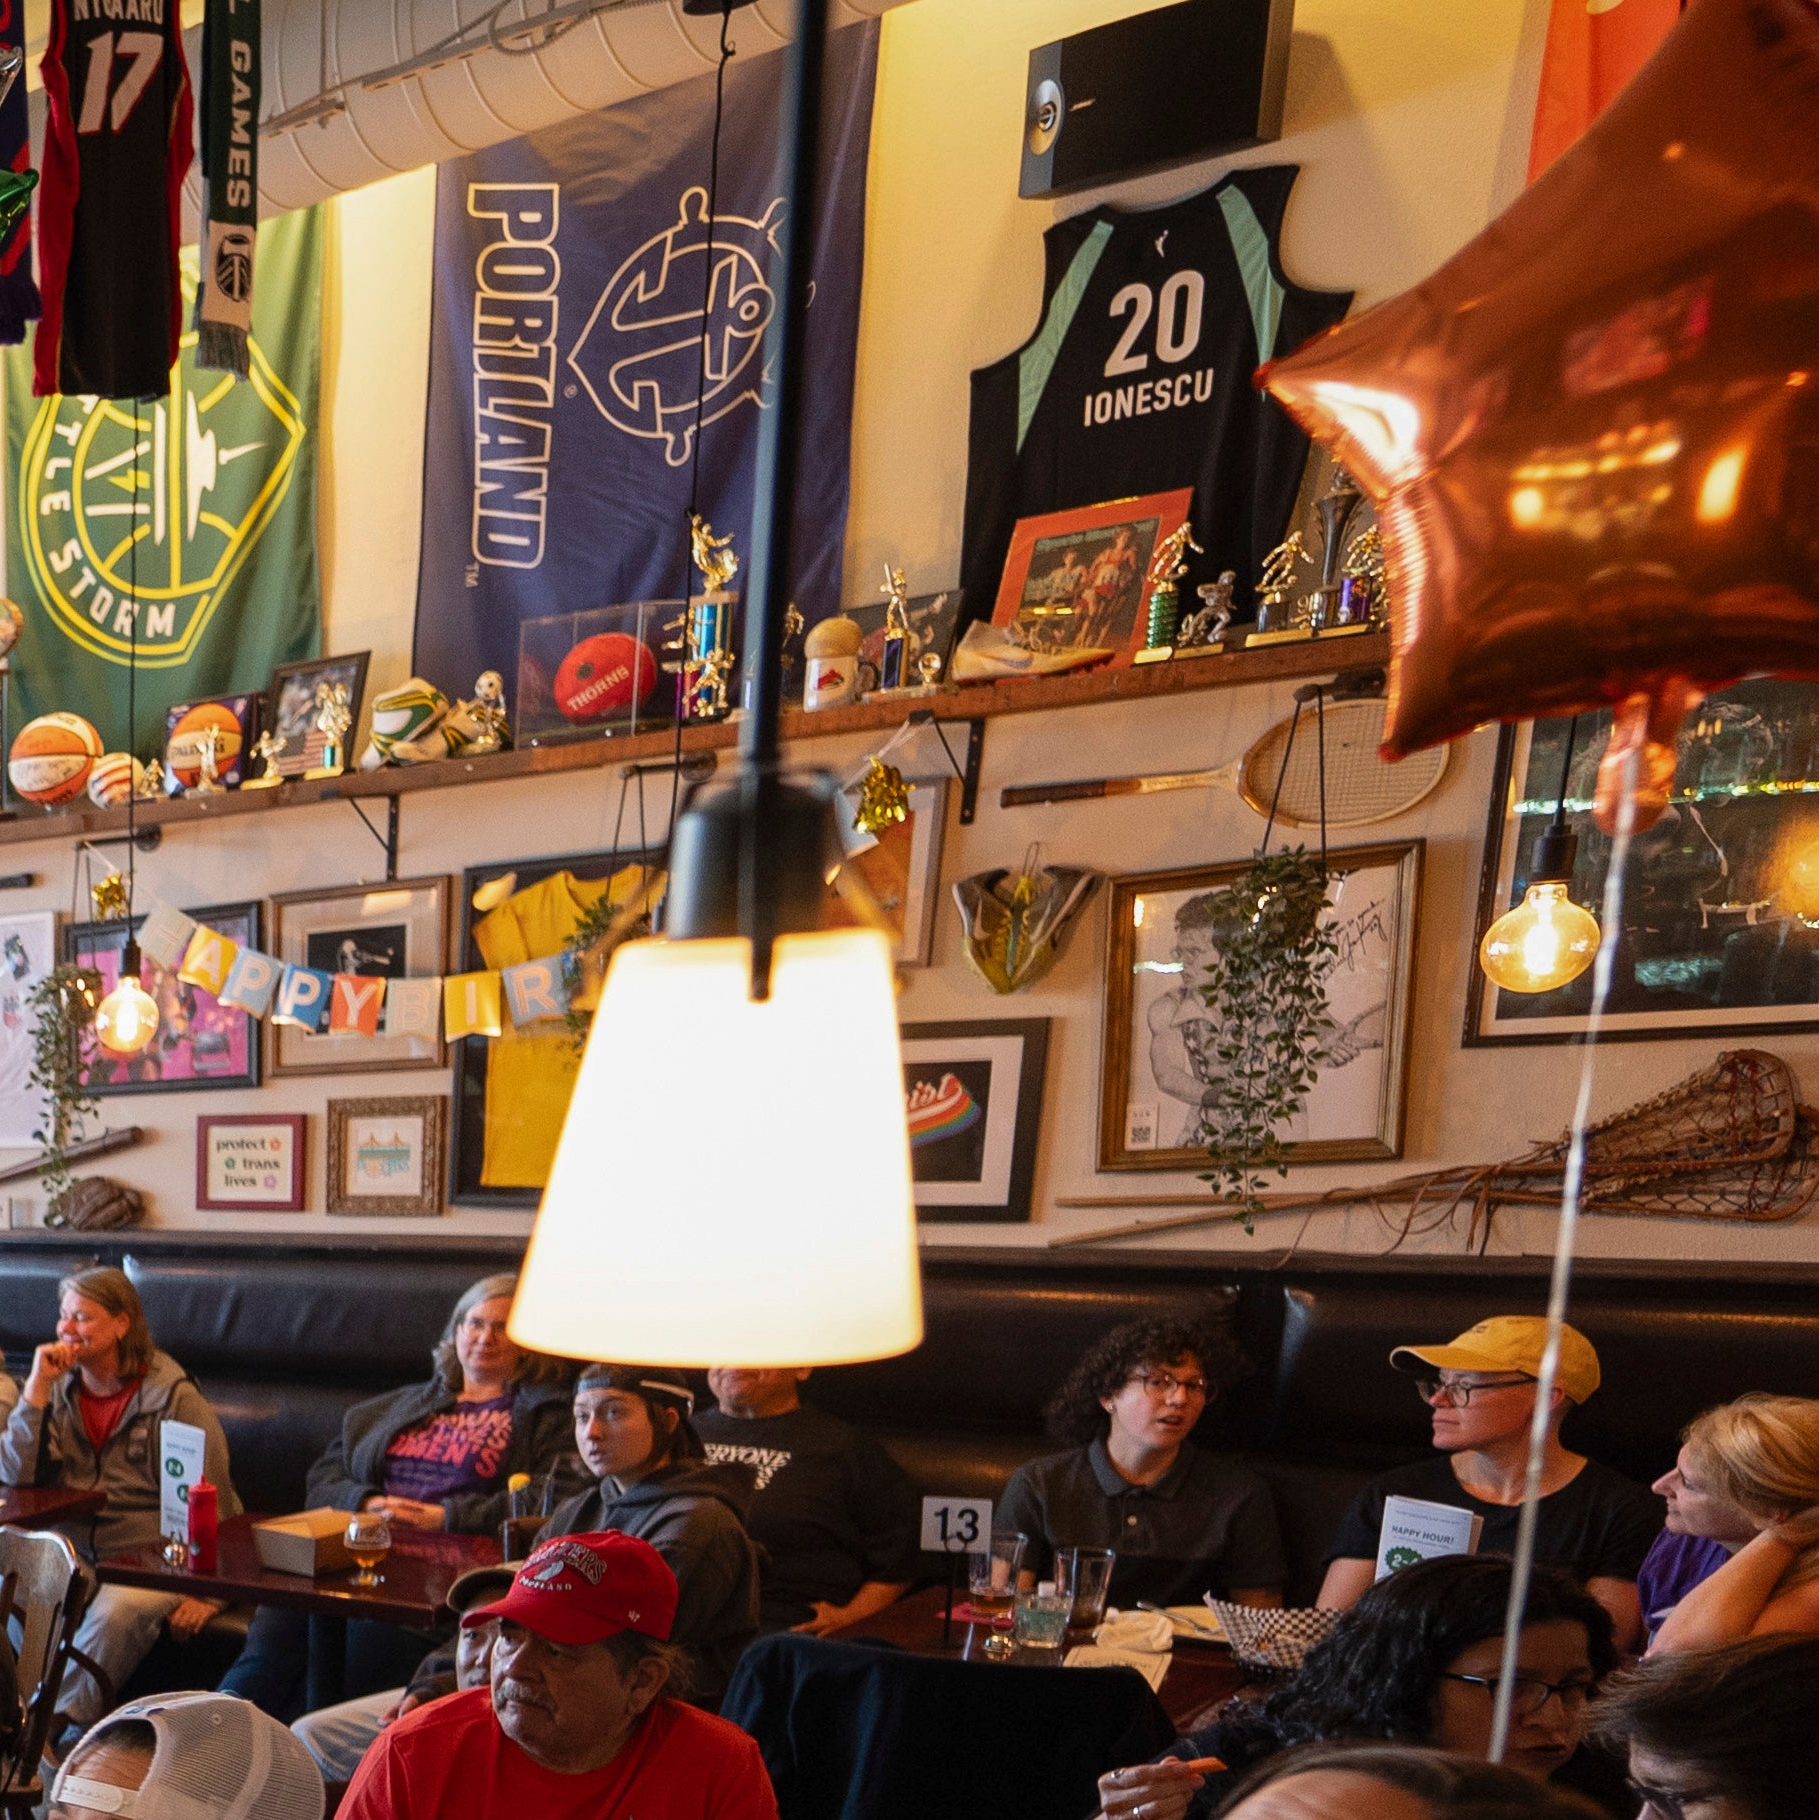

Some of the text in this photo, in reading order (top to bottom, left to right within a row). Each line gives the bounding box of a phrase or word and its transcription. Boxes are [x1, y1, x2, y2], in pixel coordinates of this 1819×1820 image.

[78, 31, 164, 136] 17
[227, 39, 254, 208] GAMES
[1104, 268, 1206, 378] 20
[466, 182, 560, 570] PORTLAND
[1082, 368, 1215, 428] IONESCU
[51, 538, 176, 640] STORM
[216, 1137, 266, 1153] protect
[242, 1158, 280, 1169] trans
[224, 1173, 258, 1188] lives
[934, 1507, 979, 1543] 13
[1391, 1525, 1455, 1546] HAPPY HOUR!
